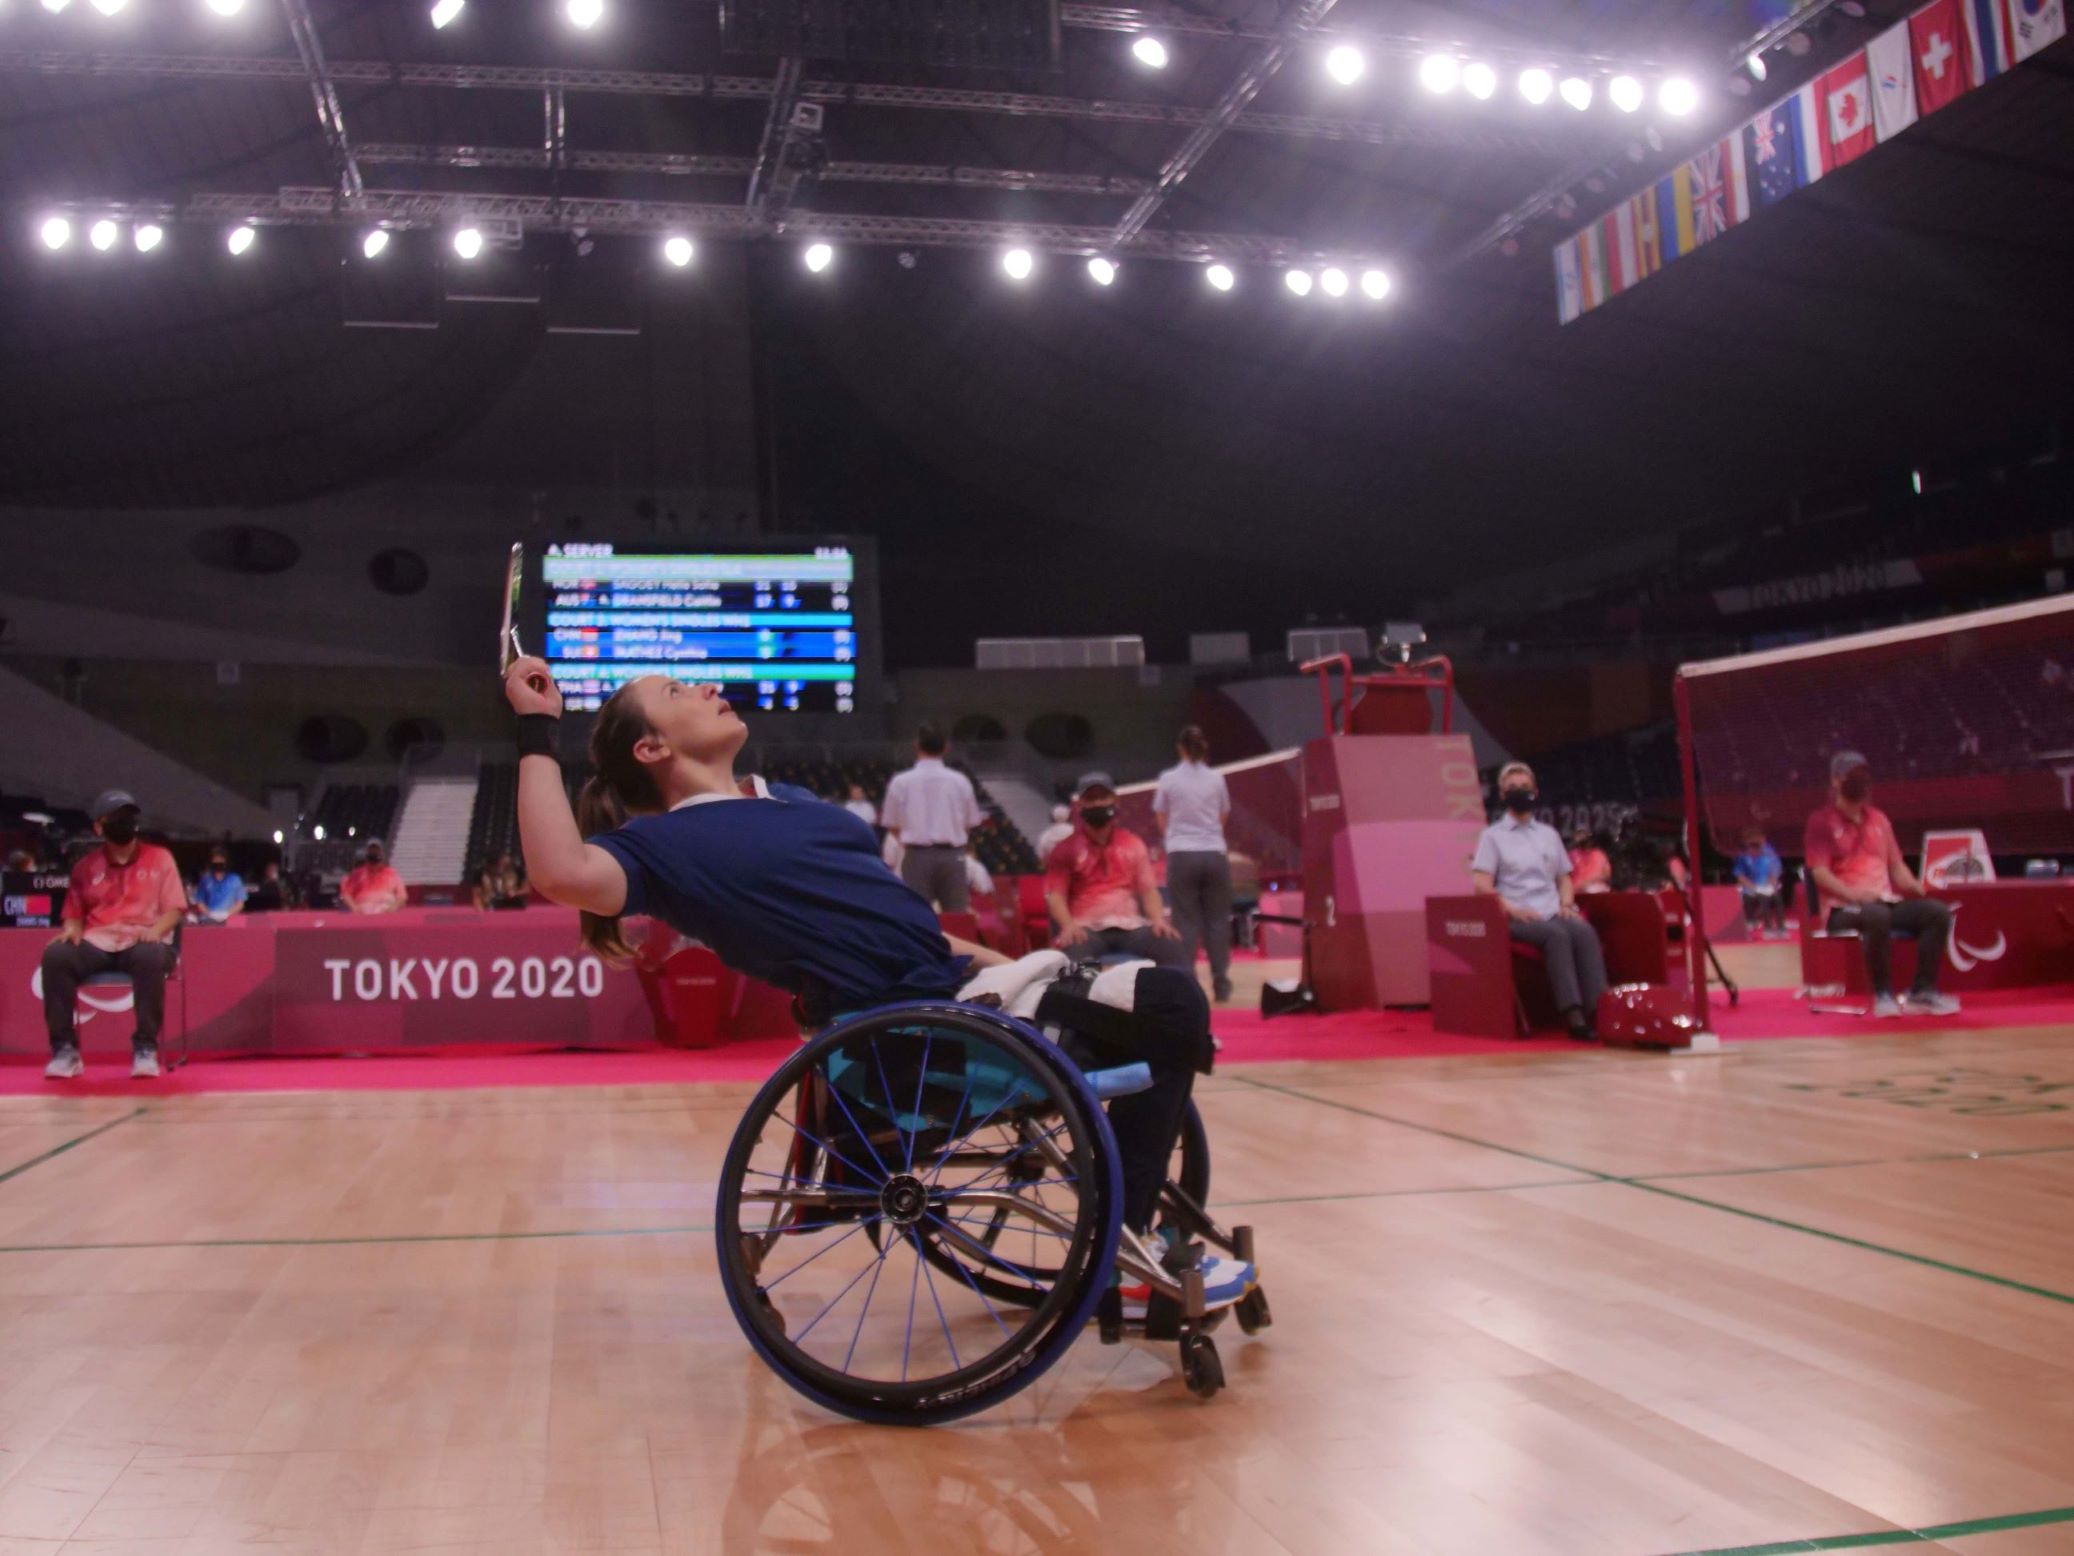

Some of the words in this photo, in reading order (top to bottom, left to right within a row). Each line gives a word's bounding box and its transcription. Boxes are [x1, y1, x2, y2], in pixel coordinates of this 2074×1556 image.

[563, 543, 613, 558] SERVER
[1325, 895, 1337, 927] 2
[324, 958, 479, 1000] TOKYO
[491, 956, 604, 999] 2020
